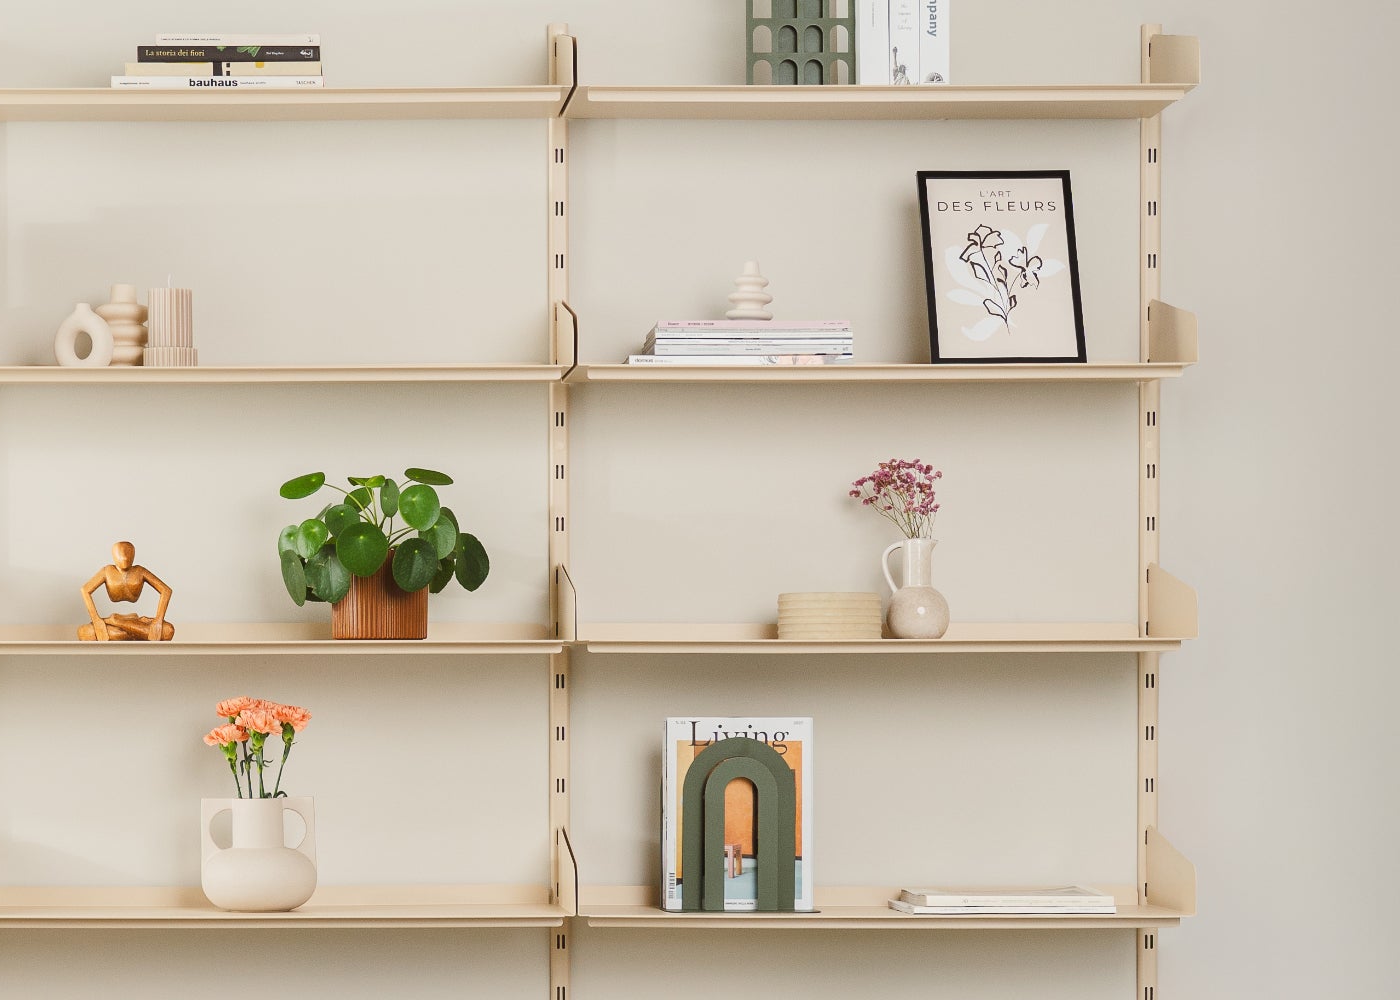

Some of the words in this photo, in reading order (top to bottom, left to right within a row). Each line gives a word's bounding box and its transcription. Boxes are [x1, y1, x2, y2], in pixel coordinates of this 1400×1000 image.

[145, 49, 154, 57] La
[155, 49, 176, 57] storia
[177, 49, 189, 57] dei
[190, 49, 205, 57] fiori
[189, 78, 238, 87] bauhaus
[979, 190, 1012, 198] L'ART
[937, 201, 973, 212] DES
[983, 201, 1057, 212] FLEURS
